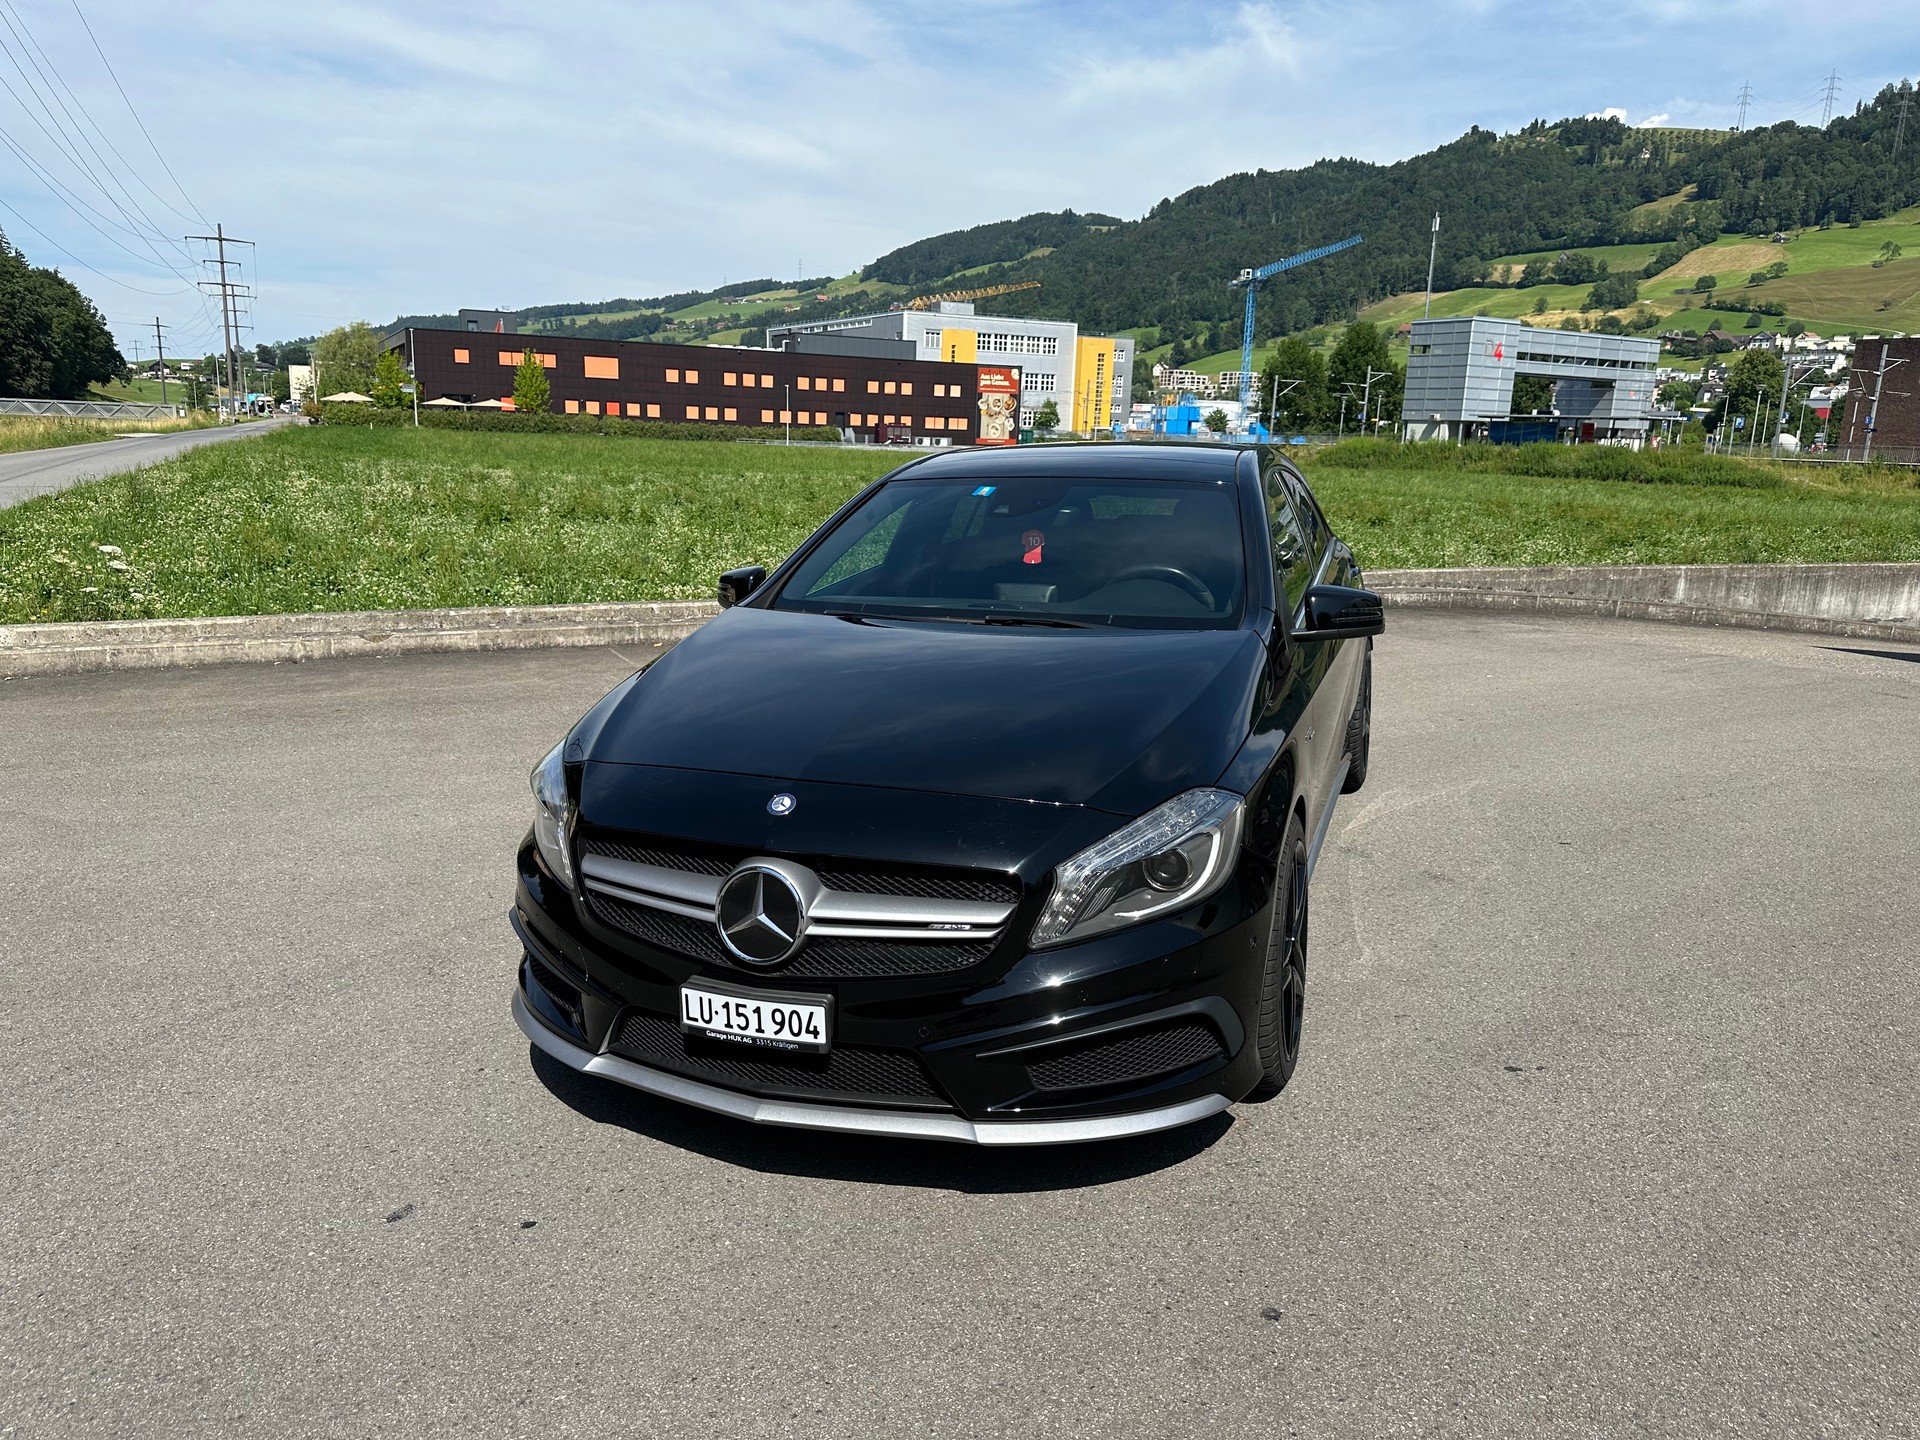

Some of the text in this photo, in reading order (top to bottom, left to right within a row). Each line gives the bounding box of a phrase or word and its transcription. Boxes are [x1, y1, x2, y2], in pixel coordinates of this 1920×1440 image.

[1028, 536, 1040, 546] 10
[706, 1030, 727, 1040] Garage
[728, 1034, 742, 1042] HUK
[756, 1038, 772, 1047] 3315
